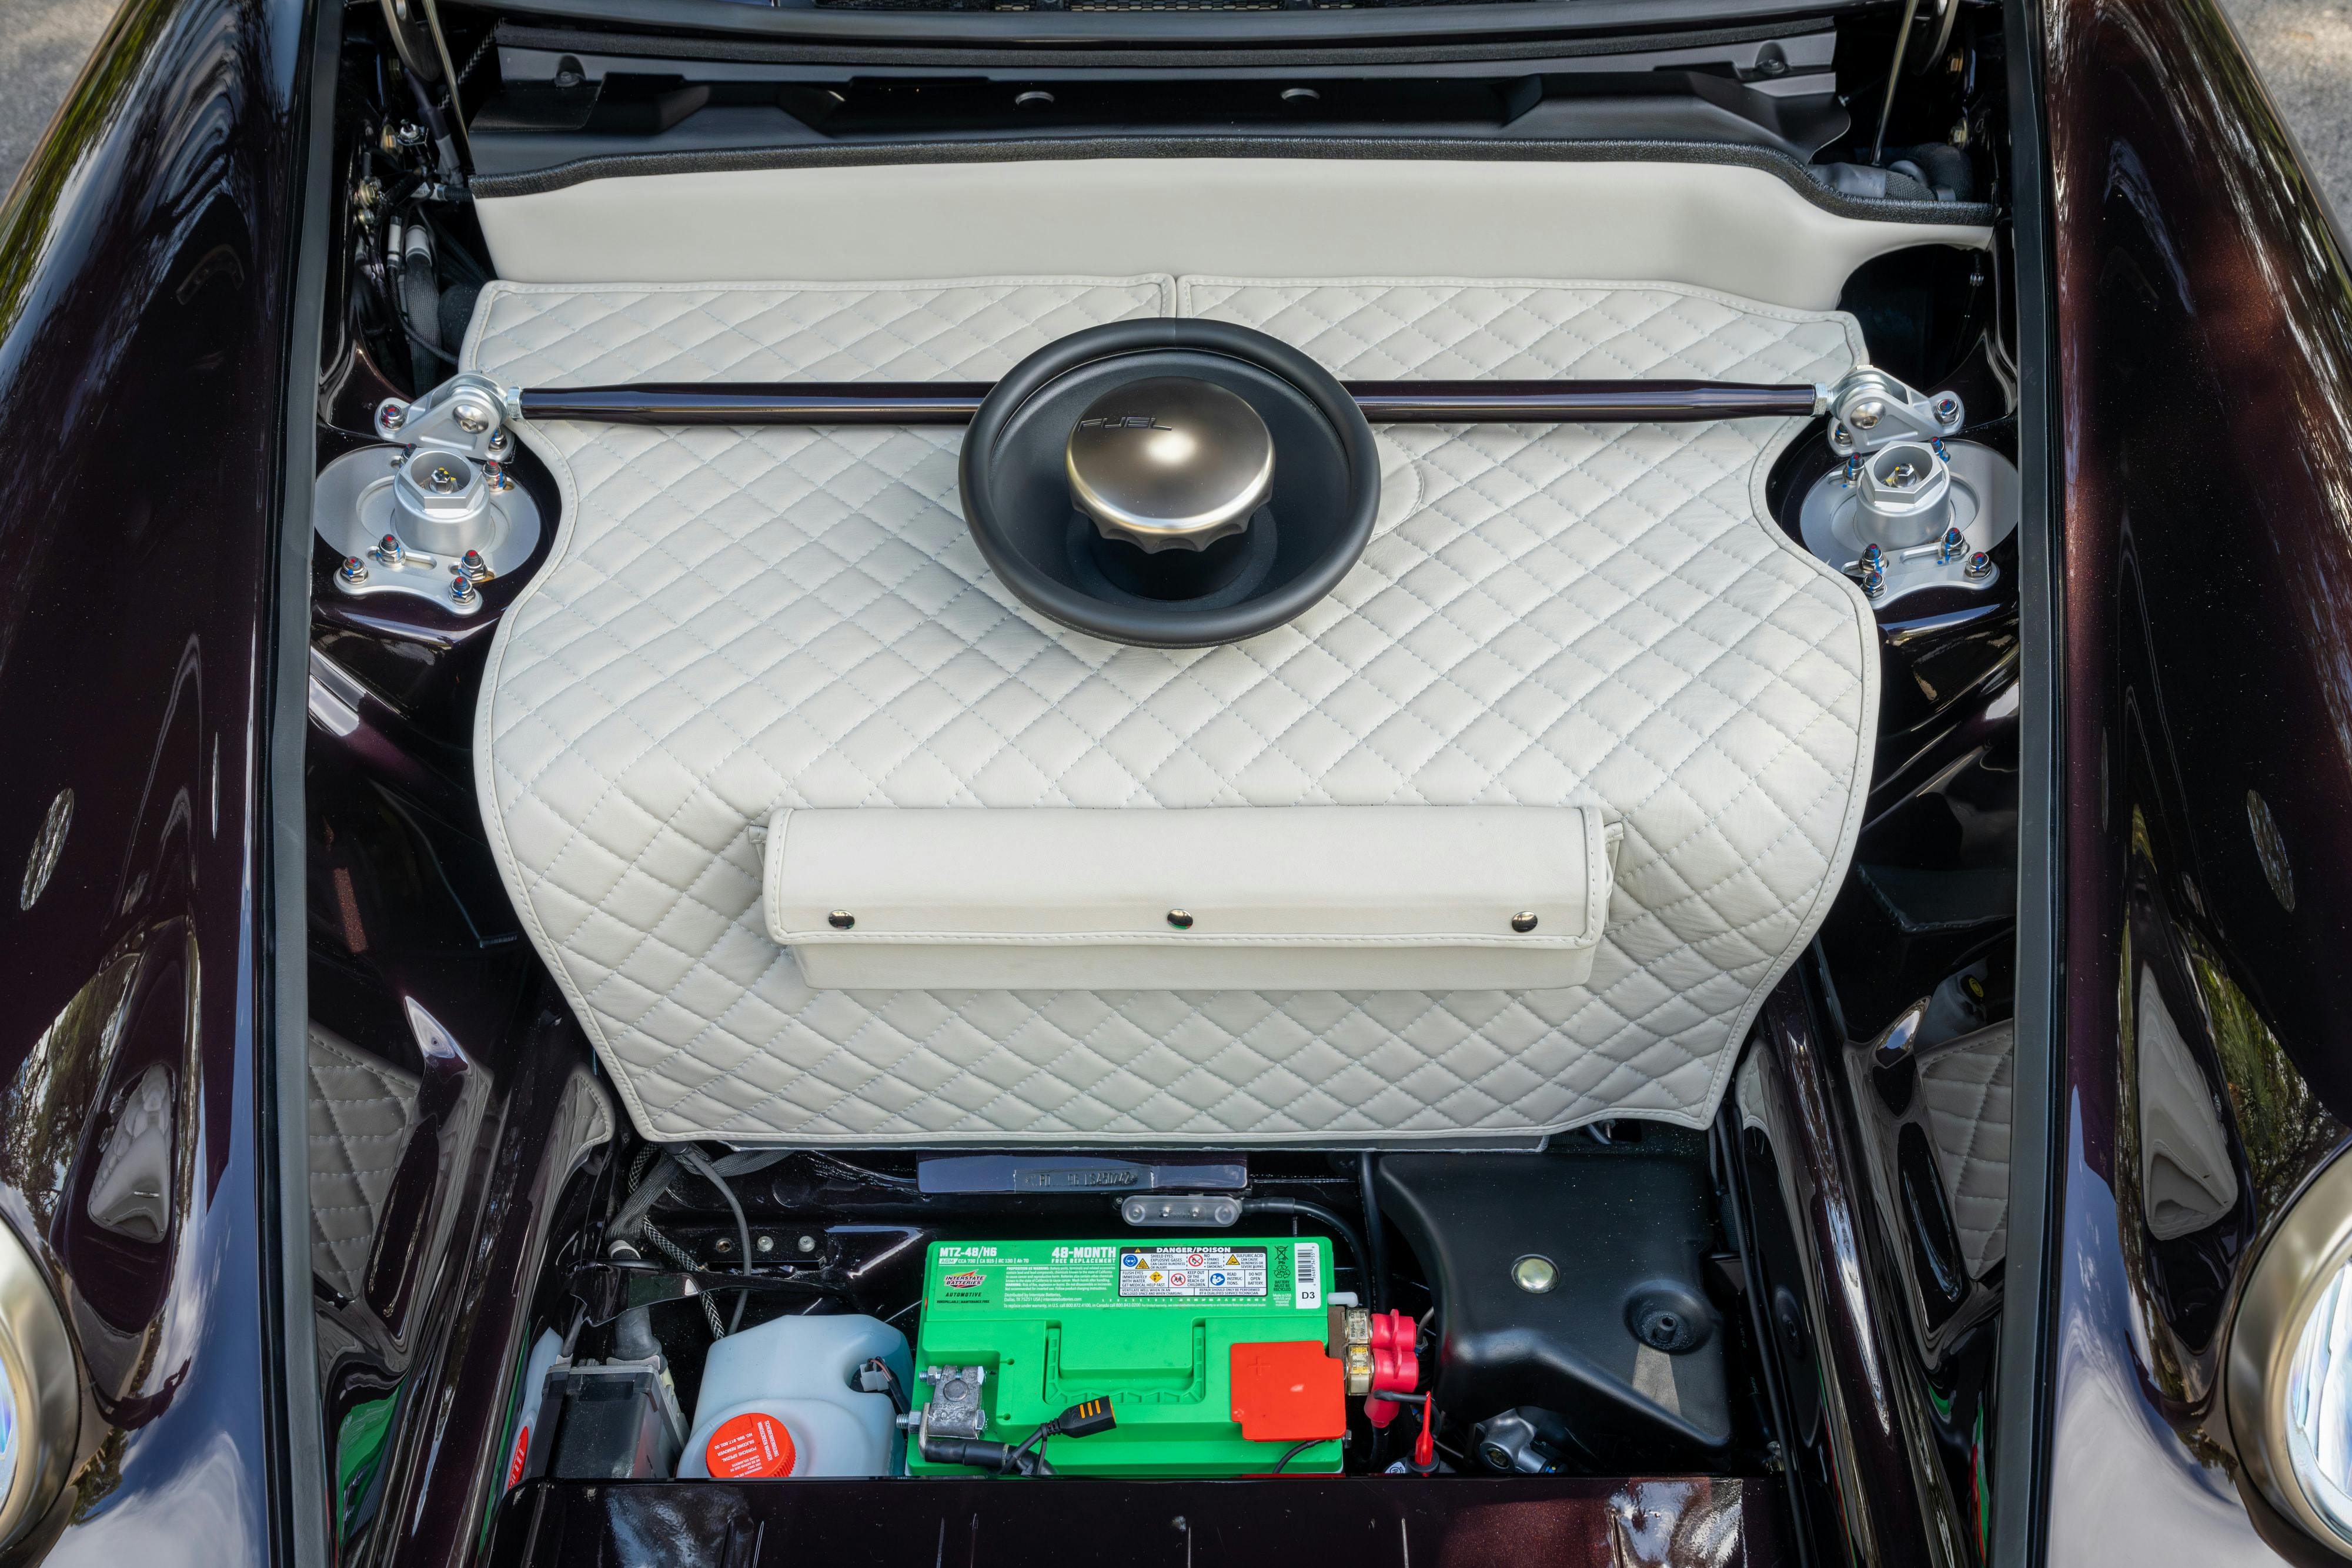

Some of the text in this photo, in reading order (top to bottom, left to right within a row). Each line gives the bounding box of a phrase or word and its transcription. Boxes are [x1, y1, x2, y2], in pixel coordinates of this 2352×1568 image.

[1078, 417, 1172, 432] FUEL
[940, 1246, 997, 1258] MTZ-48/H6
[1051, 1247, 1116, 1258] 48-MONTH
[717, 1439, 755, 1457] SILICONE REMOVER
[757, 1422, 773, 1461] WINDSCREEN WASHER
[721, 1446, 757, 1462] PORSCHE SPEZIAL
